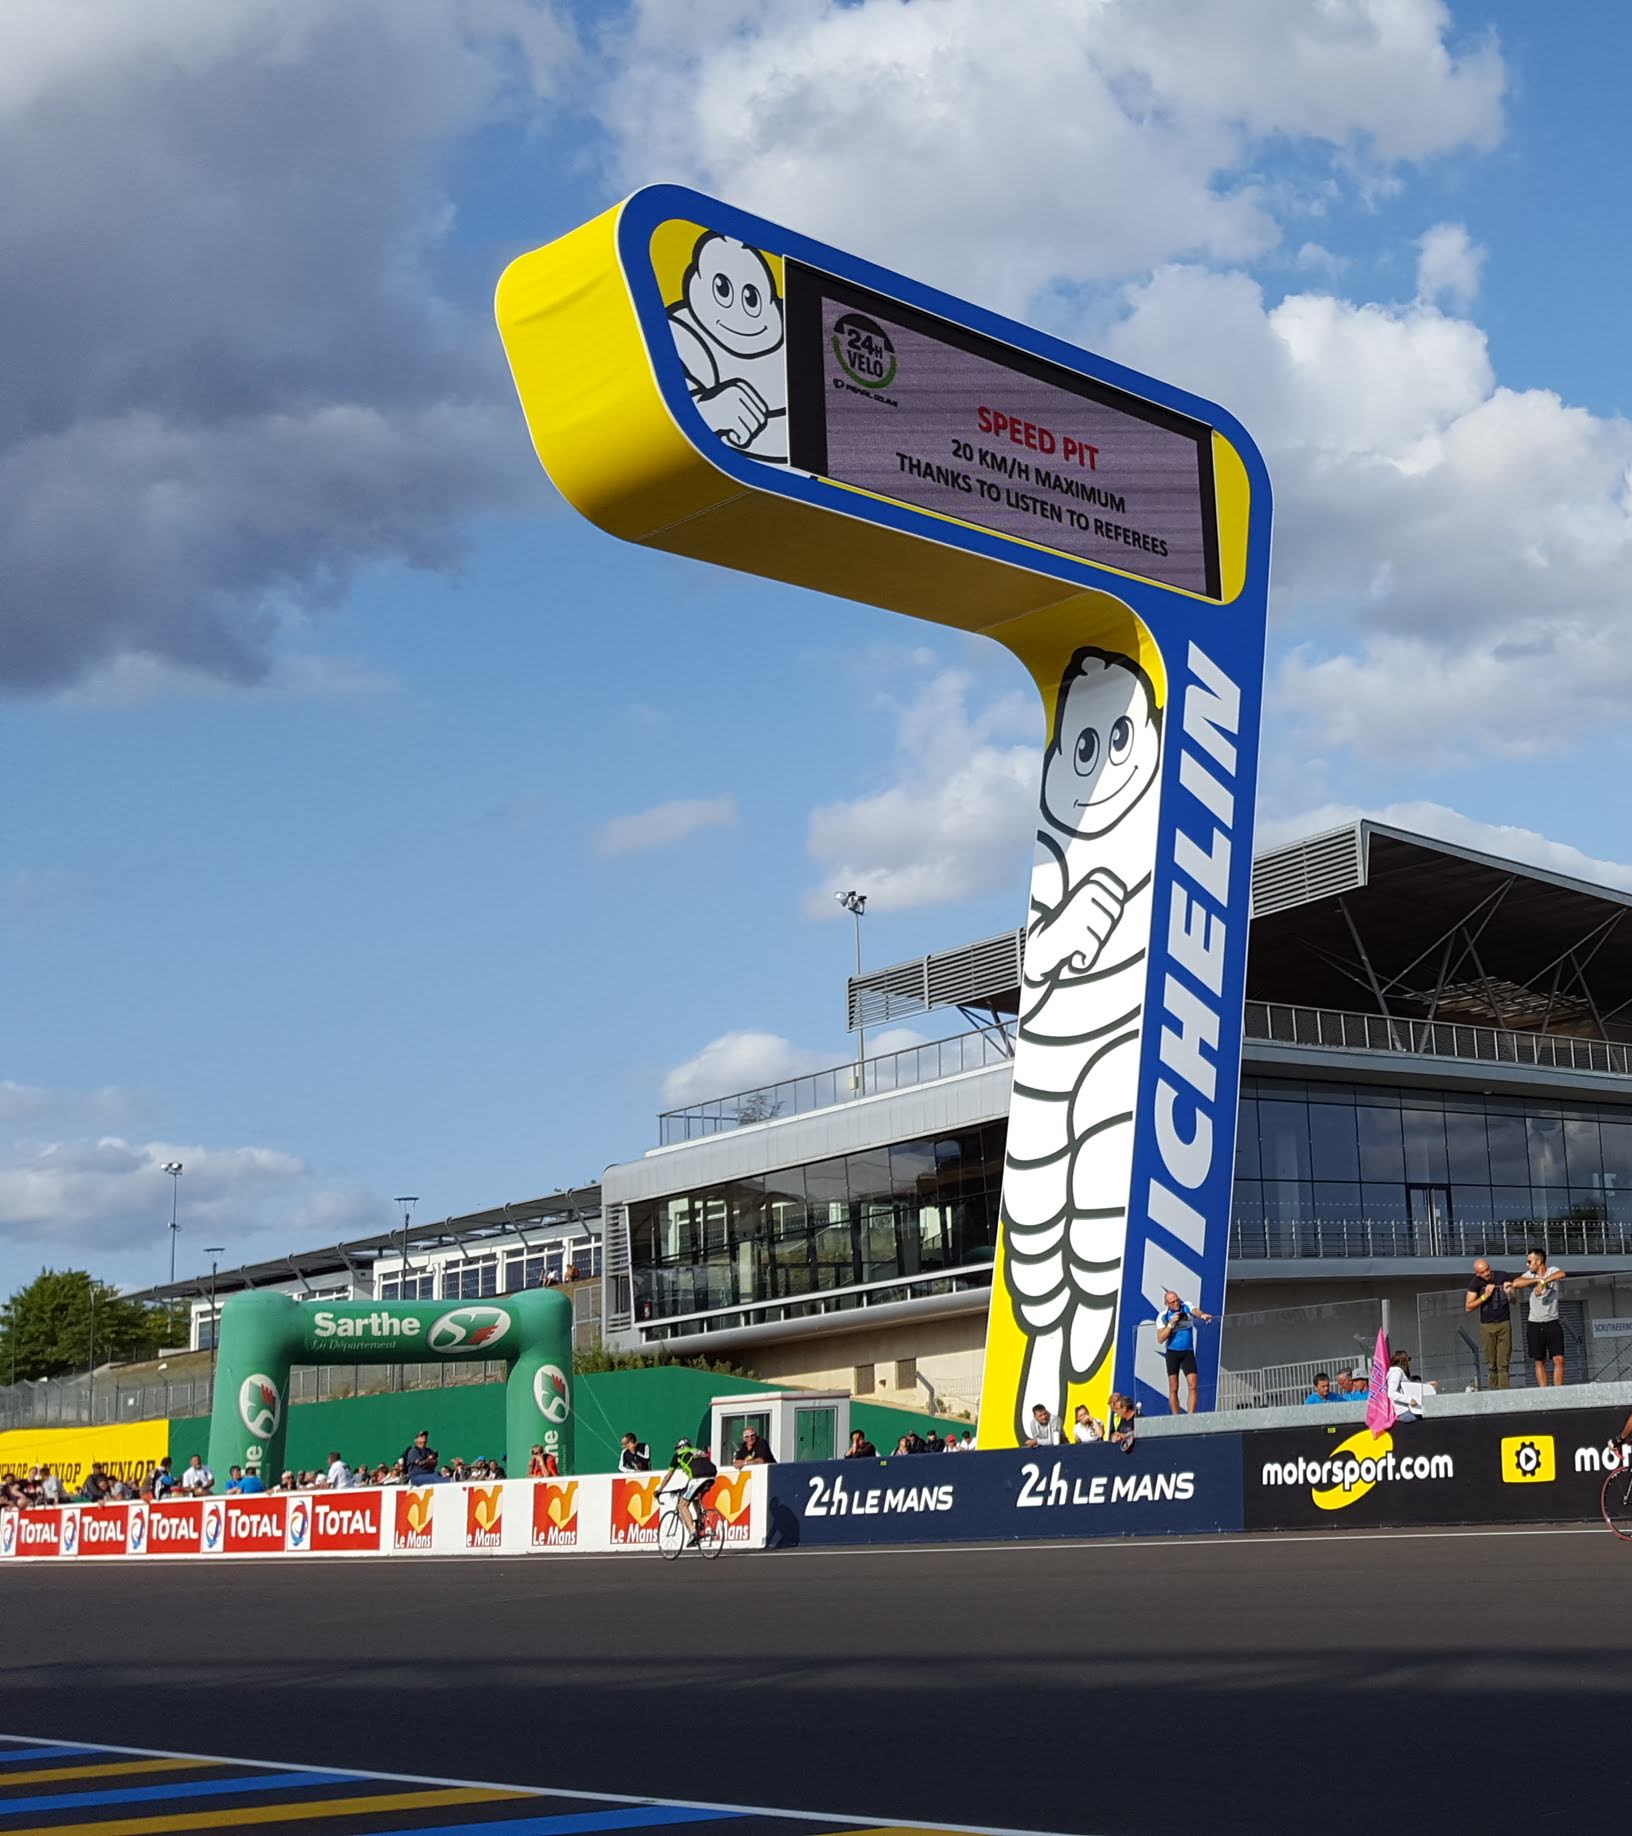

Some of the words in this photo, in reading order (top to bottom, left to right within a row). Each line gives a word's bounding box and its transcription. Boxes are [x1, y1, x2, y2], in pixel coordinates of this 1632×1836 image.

[976, 406, 1056, 454] SPEED
[1063, 435, 1099, 471] PIT
[951, 439, 974, 462] 20
[978, 448, 1029, 482] KM/H
[1035, 469, 1126, 514] MAXIMUM
[896, 452, 973, 493] THANKS
[976, 478, 1000, 502] TO
[1006, 488, 1062, 524] LISTEN
[1066, 507, 1089, 531] TO
[1094, 519, 1168, 558] REFEREES
[1134, 640, 1240, 1412] MICHELIN
[314, 1311, 421, 1337] Sarthe
[1016, 1461, 1068, 1508] 24h
[1072, 1477, 1107, 1505] LE
[1111, 1471, 1195, 1502] MANS
[1262, 1452, 1454, 1490] motorsport.com
[805, 1475, 849, 1517] 24h
[851, 1489, 879, 1515] LE
[883, 1485, 953, 1513] MANS
[19, 1518, 59, 1544] TOTAL
[81, 1515, 125, 1543] TOTAL
[150, 1512, 199, 1541] TOTAL
[227, 1508, 283, 1539] TOTAL
[314, 1504, 377, 1536] TOTAL
[611, 1523, 625, 1543] Le
[626, 1522, 659, 1543] Mans
[715, 1519, 749, 1541] Mans
[394, 1530, 405, 1549] Le
[406, 1530, 433, 1548] Mans
[473, 1527, 500, 1547] Mans
[532, 1526, 545, 1546] Le
[547, 1526, 577, 1545] Mans
